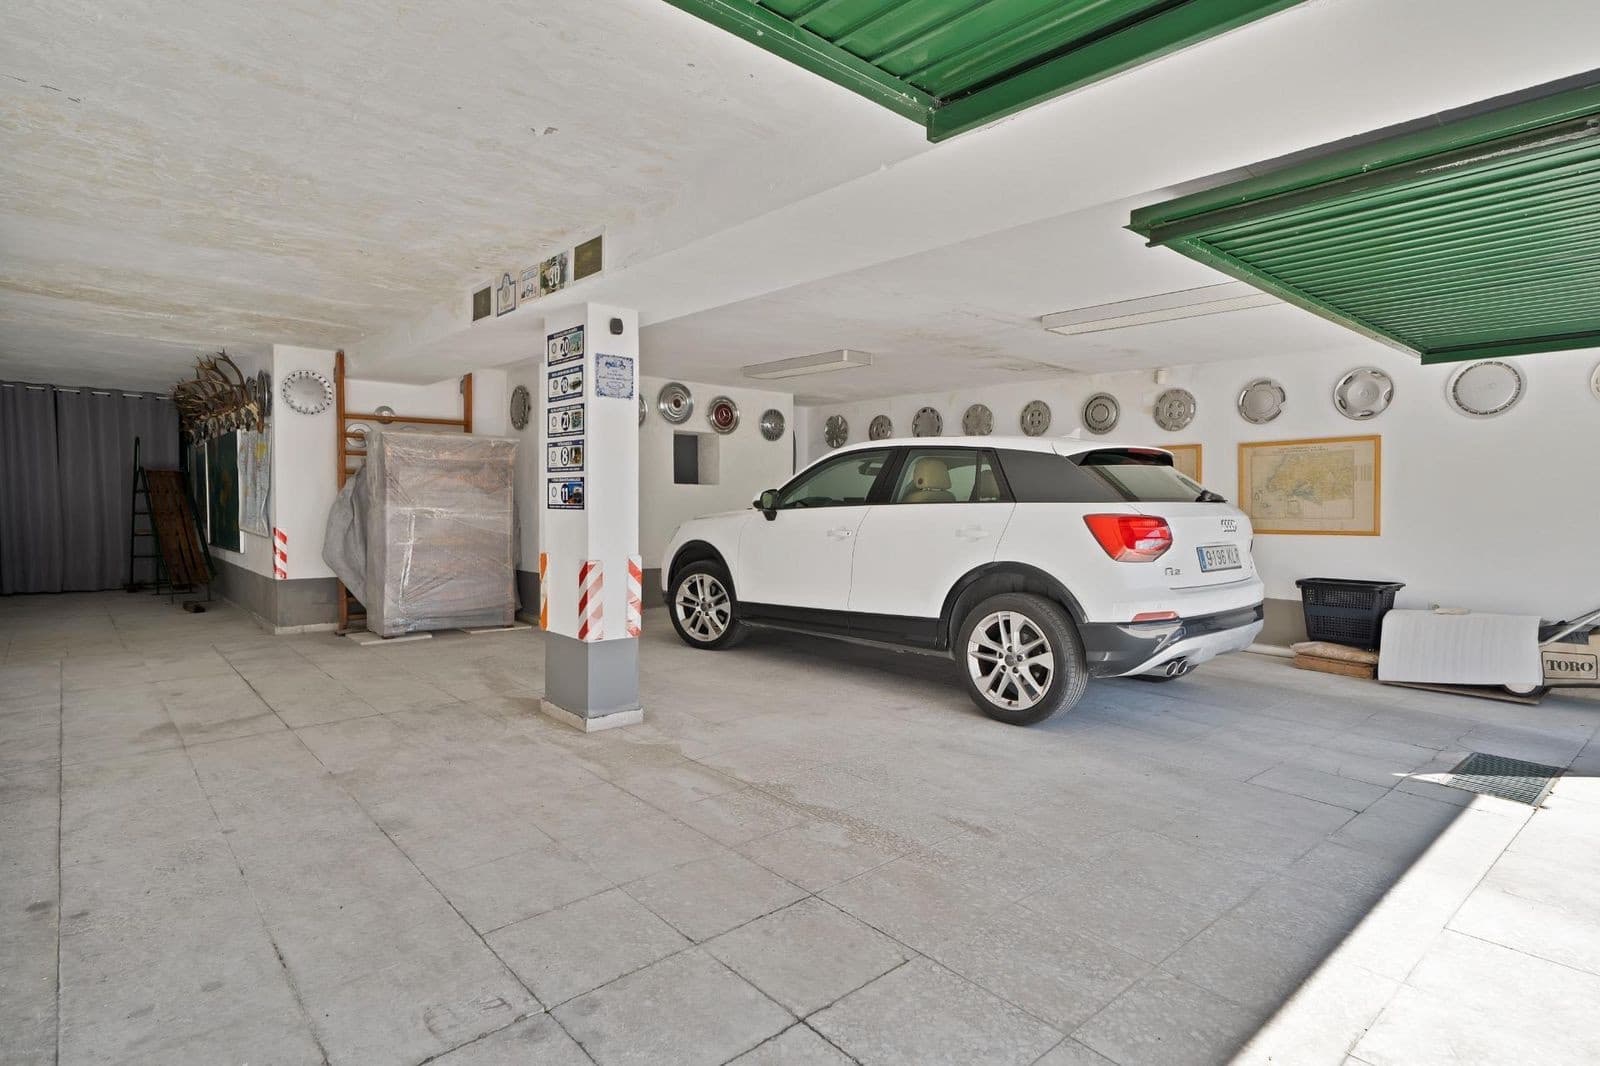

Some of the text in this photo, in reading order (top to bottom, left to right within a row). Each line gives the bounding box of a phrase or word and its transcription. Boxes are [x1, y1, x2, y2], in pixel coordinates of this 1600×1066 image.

[549, 265, 560, 286] 30
[562, 447, 568, 465] 8
[562, 487, 568, 501] 11
[1546, 660, 1594, 672] TORO
